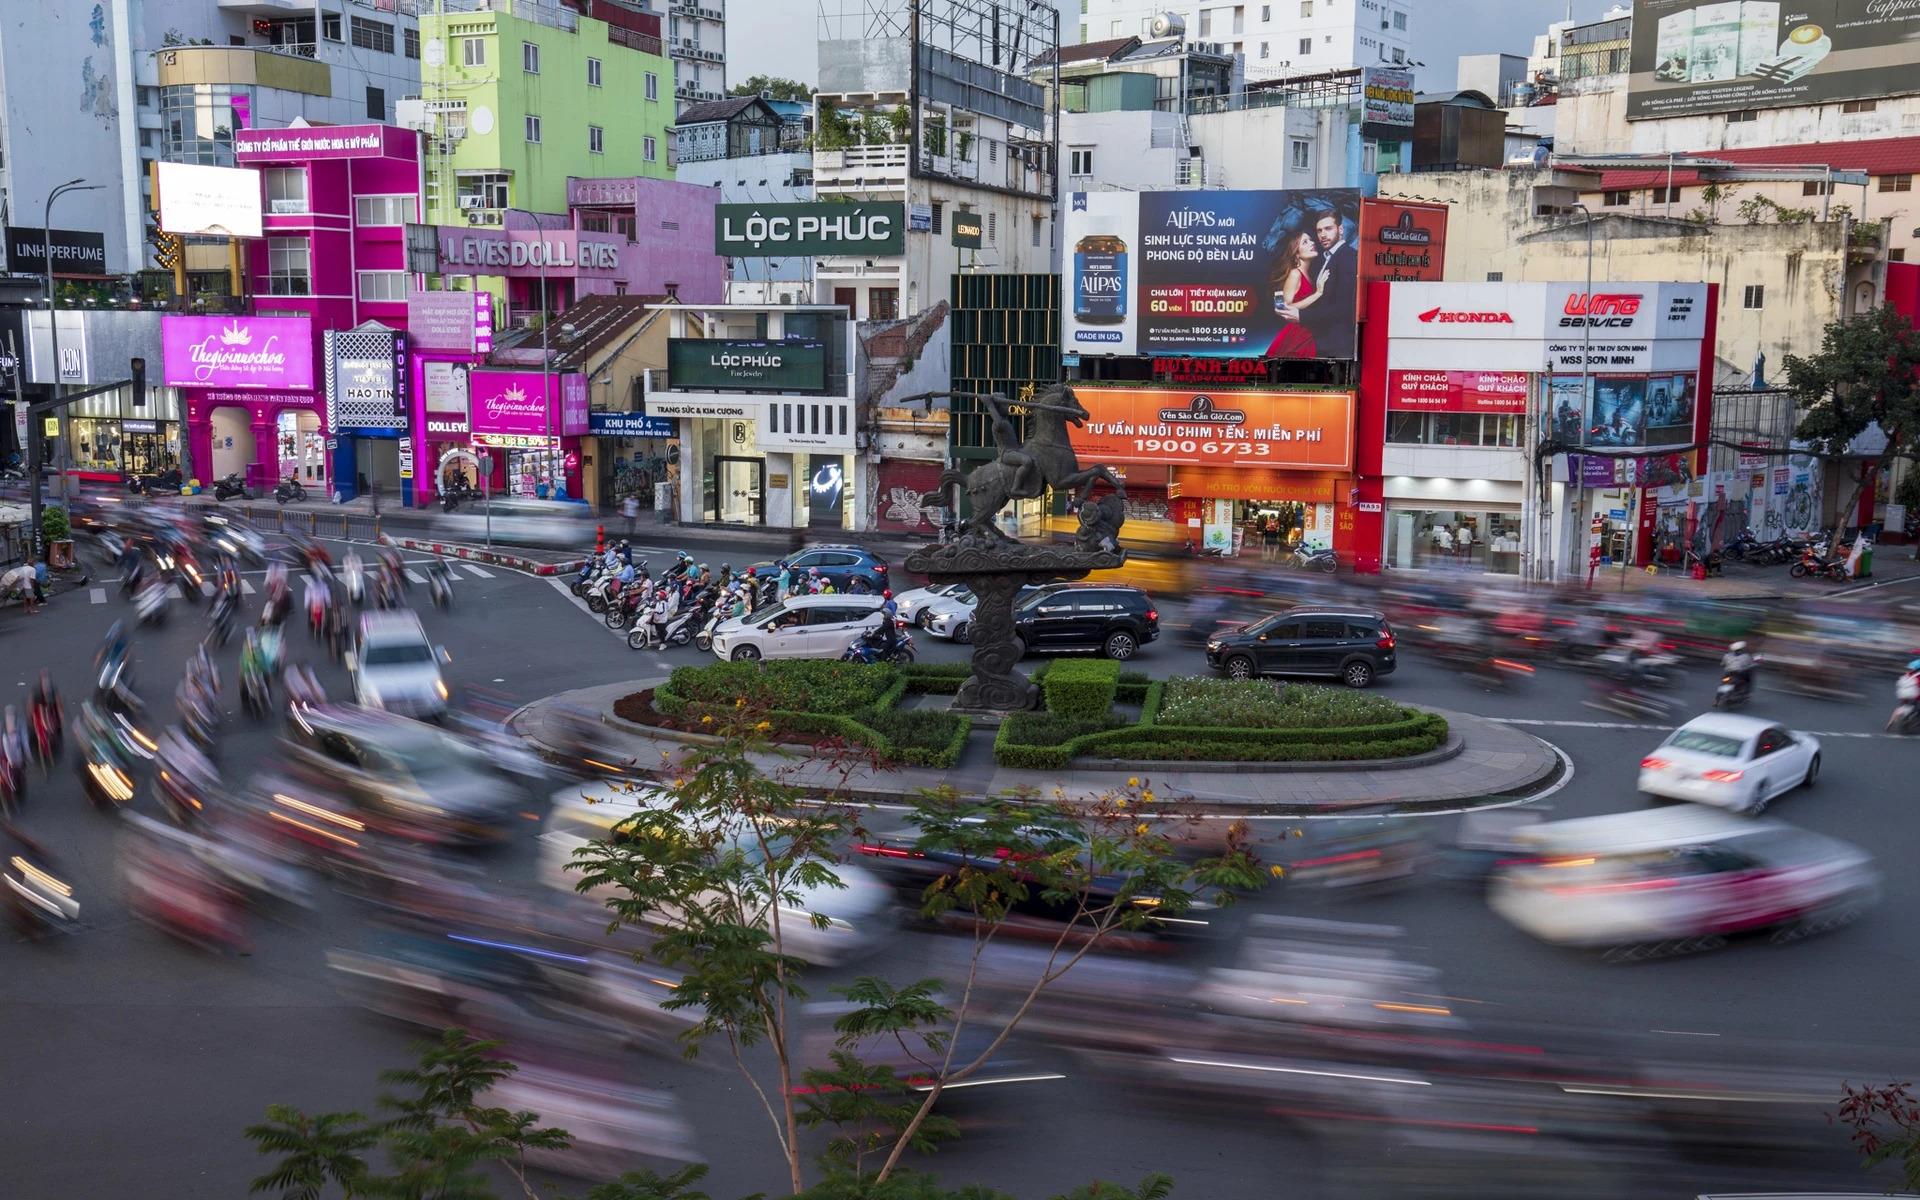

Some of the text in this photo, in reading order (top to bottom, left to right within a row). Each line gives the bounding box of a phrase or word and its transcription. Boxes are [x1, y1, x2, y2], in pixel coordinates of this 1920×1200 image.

[253, 141, 261, 152] TY
[1218, 216, 1235, 227] MỚI
[723, 211, 791, 249] LỘC
[797, 209, 891, 241] PHÚC
[1144, 232, 1257, 247] SINH LỰC SUNG MÃN
[16, 243, 103, 260] LINH PERFUME
[463, 238, 510, 266] EYES
[511, 240, 619, 268] DOLL EYES
[1146, 247, 1254, 263] PHONG ĐỘ BỀN LÂU
[1169, 288, 1184, 297] LỚN
[1150, 300, 1168, 312] 60
[1439, 312, 1514, 323] HONDA
[1549, 344, 1567, 352] CÔNG
[61, 348, 81, 371] ICON
[711, 351, 782, 369] LỘC PHÚC
[1560, 355, 1634, 364] WSS SƠN MINH
[1228, 359, 1268, 375] HOA
[743, 370, 763, 378] Jewelry
[1403, 373, 1447, 382] KÍNH CHÀO
[1479, 374, 1525, 384] KÍNH CHÀO
[1401, 382, 1448, 391] QUÝ KHÁCH
[1477, 384, 1526, 392] QUÝ KHÁCH
[657, 406, 680, 414] TRANG
[681, 405, 694, 414] SỨC
[716, 407, 743, 415] CƯƠNG
[605, 419, 623, 428] KHU
[625, 416, 643, 428] PHỐ
[646, 421, 651, 429] 4
[1087, 422, 1105, 434] TƯ
[1108, 420, 1134, 435] VẤN
[1176, 426, 1212, 438] CHIM
[1254, 424, 1291, 440] MIỄN
[1296, 427, 1321, 441] PHÍ
[485, 435, 503, 444] Sale
[1133, 439, 1197, 452] 1900
[1202, 442, 1270, 455] 6733
